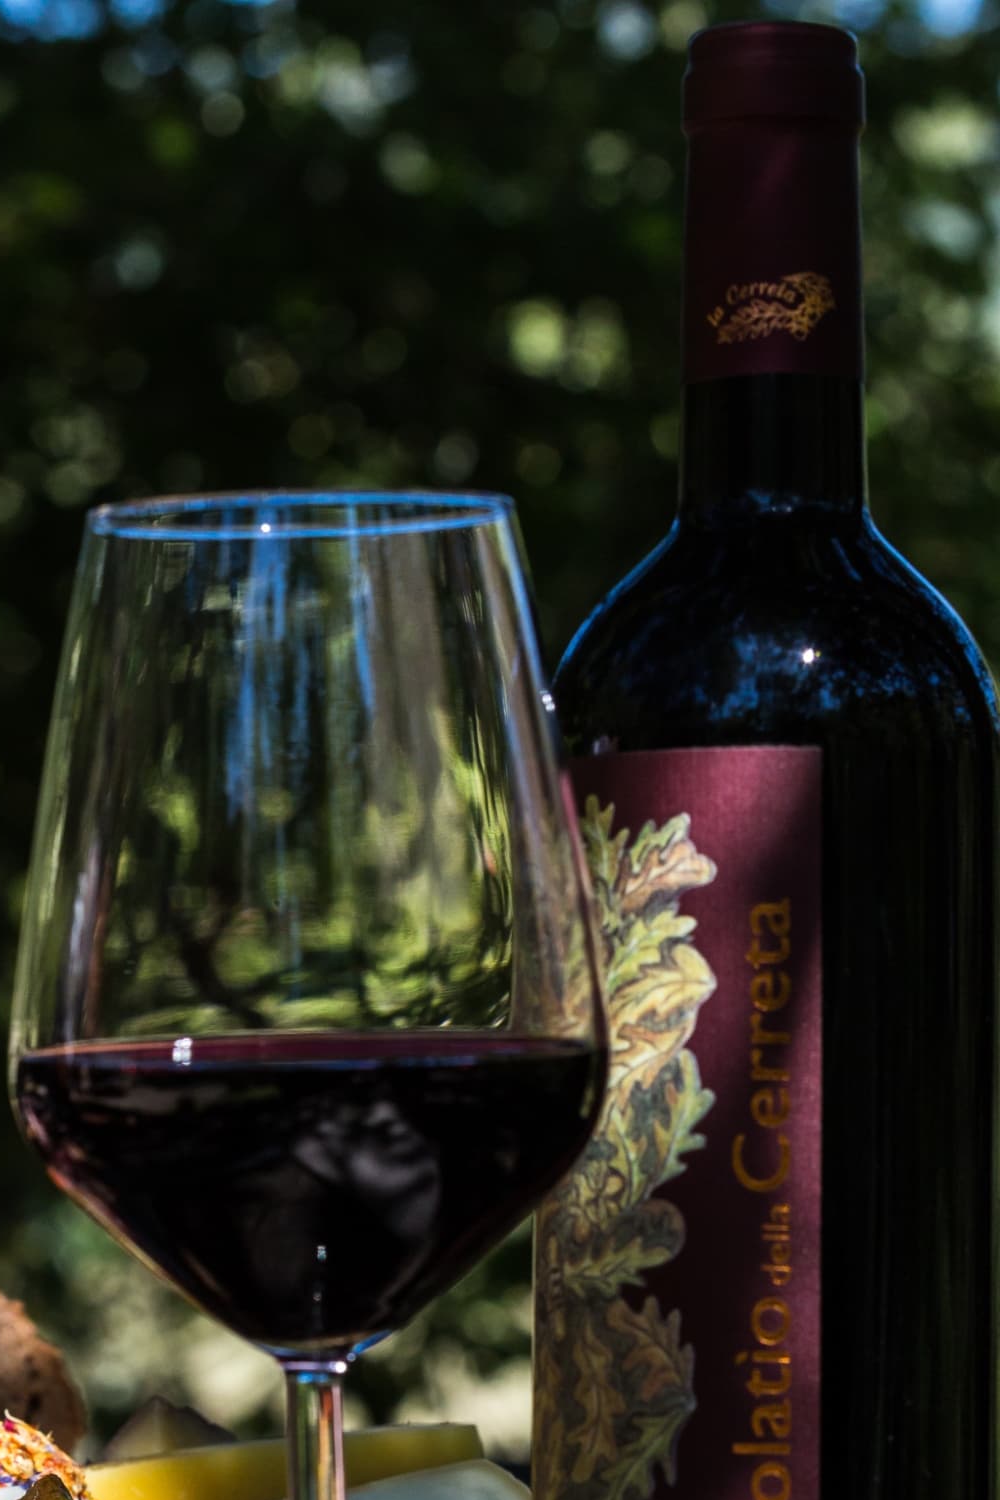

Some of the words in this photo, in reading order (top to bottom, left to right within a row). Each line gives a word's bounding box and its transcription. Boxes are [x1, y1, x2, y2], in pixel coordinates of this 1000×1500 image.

[726, 281, 797, 304] Cerreta
[731, 897, 792, 1193] Cerreta
[761, 1202, 792, 1287] della
